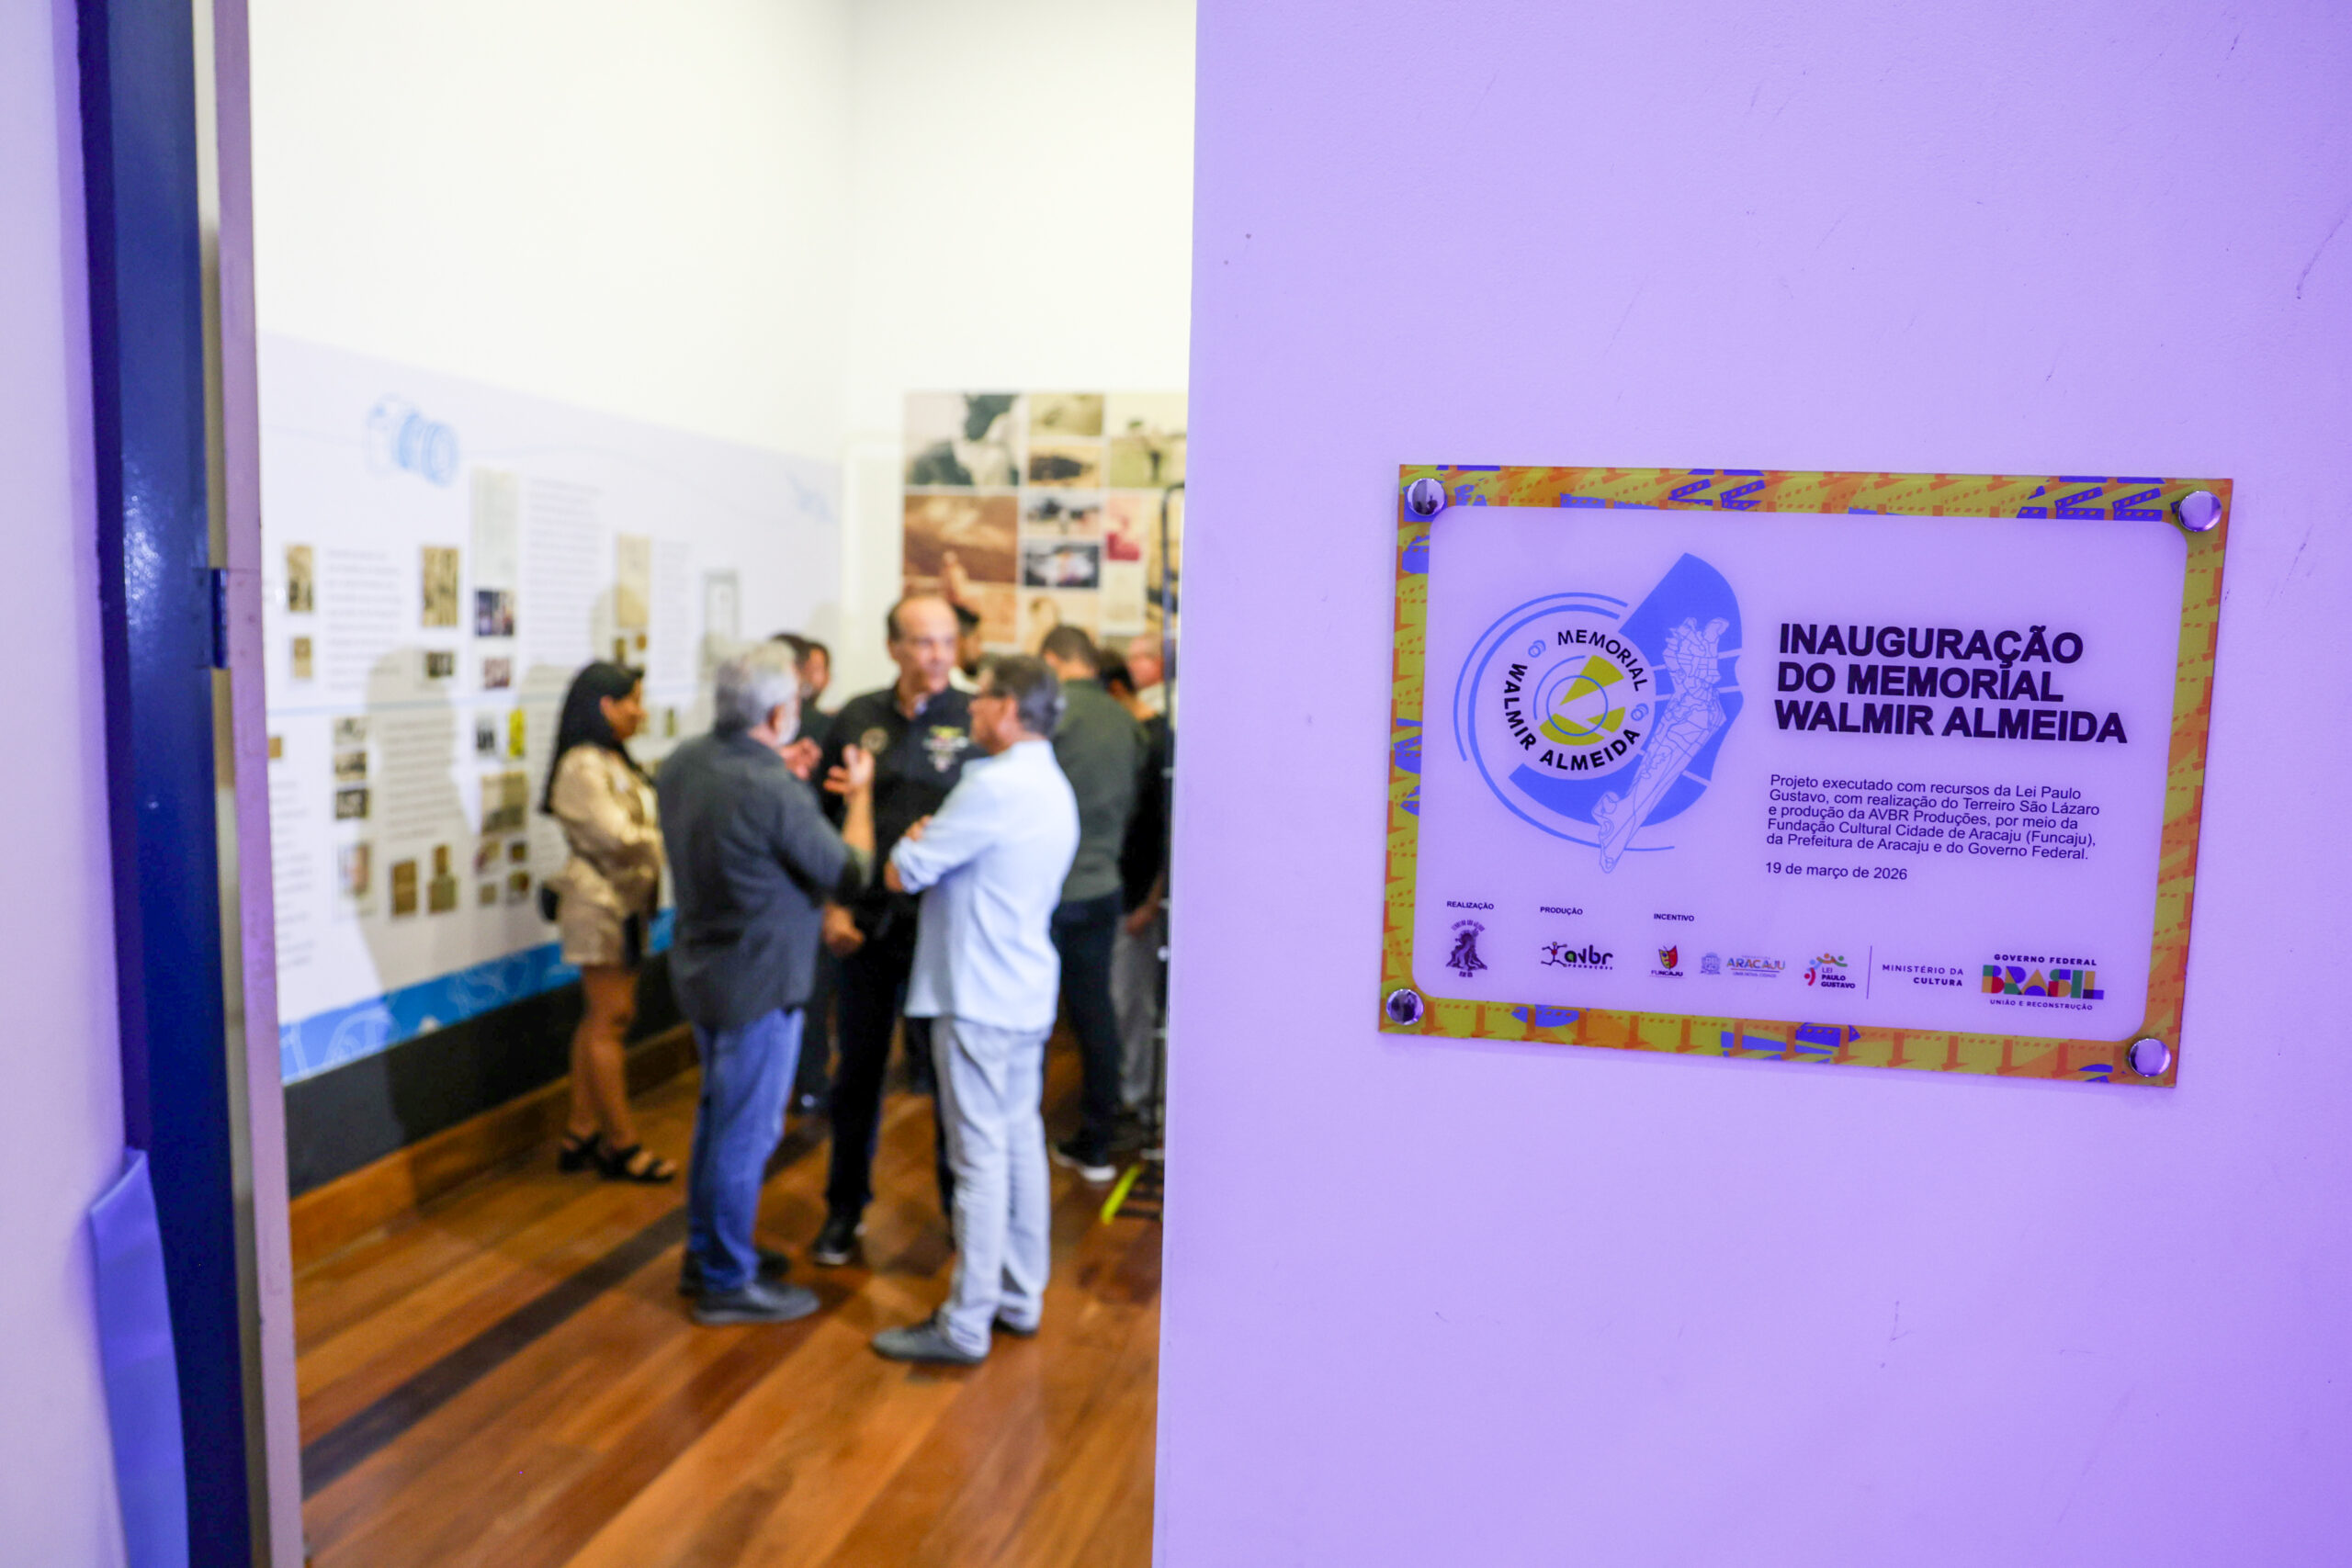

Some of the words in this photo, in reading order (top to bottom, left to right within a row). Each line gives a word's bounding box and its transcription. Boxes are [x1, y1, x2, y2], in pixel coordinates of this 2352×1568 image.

[1780, 624, 2084, 669] INAUGURAÇÃO
[1557, 629, 1648, 692] MEMORIAL
[1778, 661, 1836, 694] DO
[1847, 664, 2064, 702] MEMORIAL
[1504, 663, 1537, 750] WALMIR
[1539, 728, 1641, 771] ALMEIDA
[1774, 699, 1934, 736] WALMIR
[1941, 706, 2128, 743] ALMEIDA
[1770, 774, 1818, 790] Projeto
[1823, 779, 1893, 791] executado
[1897, 782, 1926, 793] com
[1930, 784, 1989, 795] recursos
[1994, 784, 2011, 796] da
[2016, 785, 2037, 797] Lei
[2041, 786, 2081, 800] Paulo
[1770, 788, 1829, 804] Gustavo,
[1834, 794, 1862, 804] com
[1867, 795, 1937, 809] realização
[1941, 797, 1959, 809] do
[1963, 797, 2015, 812] Terreiro
[2019, 800, 2047, 813] São
[2052, 802, 2100, 816] Lázaro
[1769, 807, 1777, 815] e
[1781, 806, 1844, 819] produção
[1849, 808, 1865, 819] da
[1868, 808, 1909, 821] AVBR
[1914, 809, 1991, 827] Produções,
[1996, 816, 2018, 828] por
[2023, 817, 2056, 829] meio
[2061, 818, 2078, 829] da
[1768, 818, 1835, 834] Fundação
[1838, 821, 1891, 835] Cultural
[1895, 824, 1944, 838] Cidade
[1949, 827, 1966, 839] de
[1969, 828, 2021, 844] Aracaju
[2026, 830, 2096, 848] (Funcaju),
[1766, 833, 1783, 845] da
[1788, 834, 1853, 848] Prefeitura
[1857, 838, 1874, 850] de
[1877, 838, 1929, 854] Aracaju
[1933, 843, 1942, 852] e
[1946, 841, 1963, 854] do
[1968, 842, 2028, 857] Governo
[2031, 845, 2088, 860] Federal.
[1766, 862, 1781, 874] 19
[1785, 863, 1803, 874] de
[1806, 866, 1849, 879] março
[1852, 866, 1870, 878] de
[1873, 867, 1907, 880] 2026
[1446, 900, 1495, 910] REALIZAÇÃO
[1540, 907, 1583, 916] PRODUÇÃO
[1654, 913, 1695, 922] INCENTIVO
[1883, 964, 1946, 976] MINISTÉRIO
[1950, 967, 1963, 976] DA
[1994, 953, 2045, 964] GOVERNO
[2050, 956, 2098, 966] FEDERAL
[1821, 981, 1856, 989] GUSTAVO
[1913, 976, 1963, 987] CULTURA
[1981, 964, 2105, 1000] BRASIL
[1990, 998, 2016, 1007] UNIÃO
[2027, 1001, 2093, 1011] RECONSTRUÇÃO
